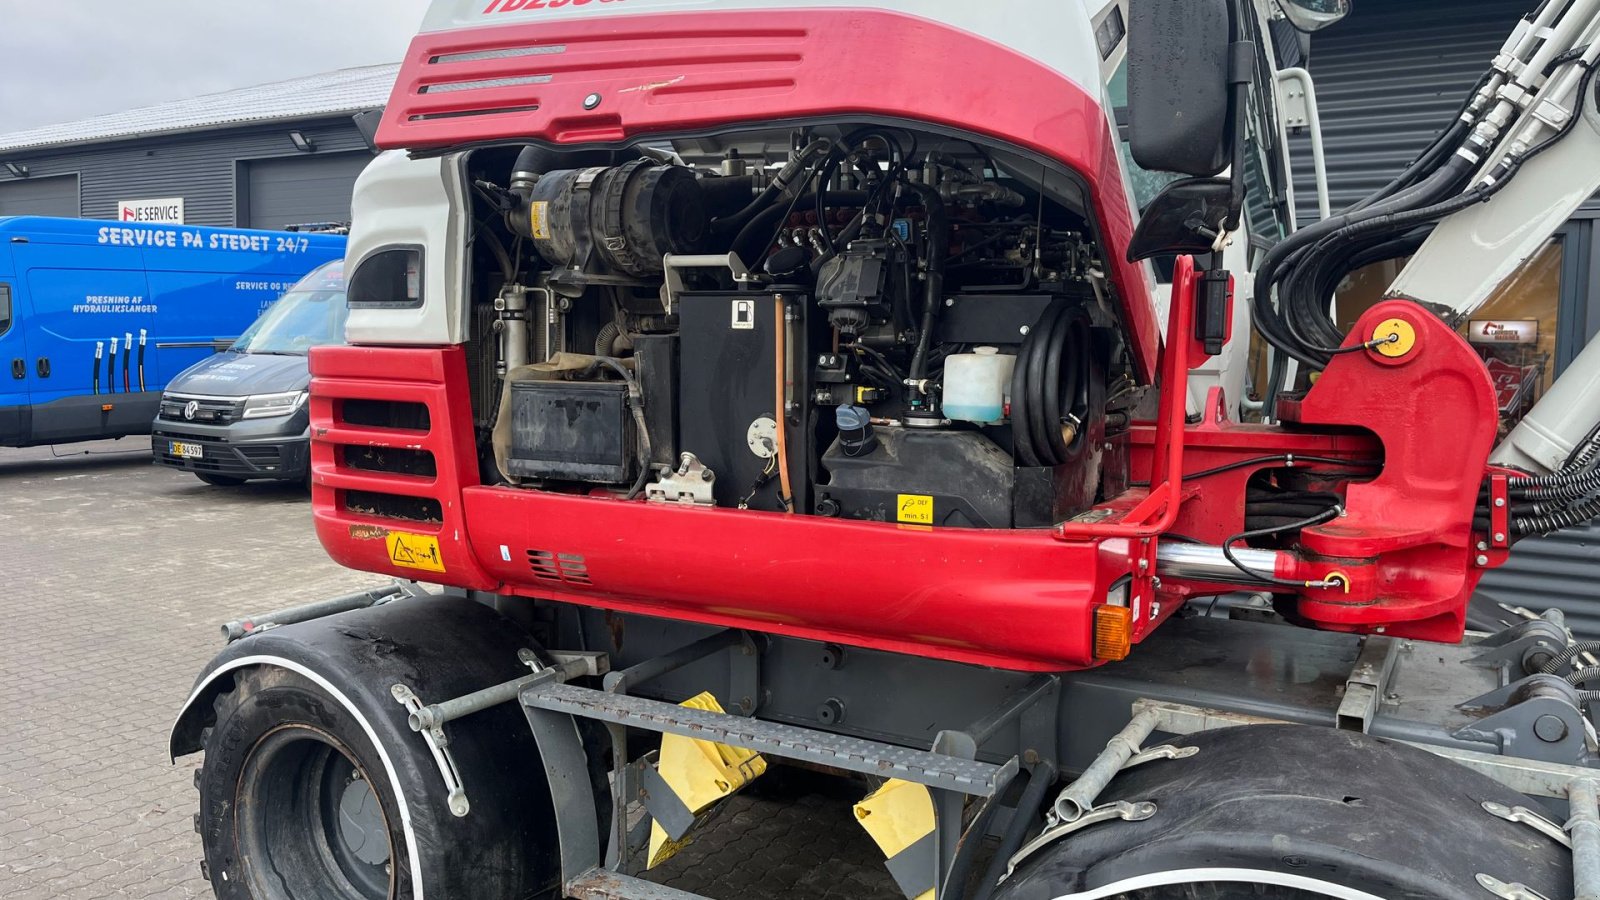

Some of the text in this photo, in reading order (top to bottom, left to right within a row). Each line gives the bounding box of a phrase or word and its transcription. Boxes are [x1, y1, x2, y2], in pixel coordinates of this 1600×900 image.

[144, 205, 178, 221] SERVICE
[97, 227, 309, 254] SERVICE PÅ STEDET 24/7
[235, 281, 268, 290] SERVICE
[270, 282, 281, 290] OG
[86, 296, 143, 304] PRESNING AF
[73, 305, 157, 313] HYDRAULIKSLANGER
[173, 444, 181, 453] DE
